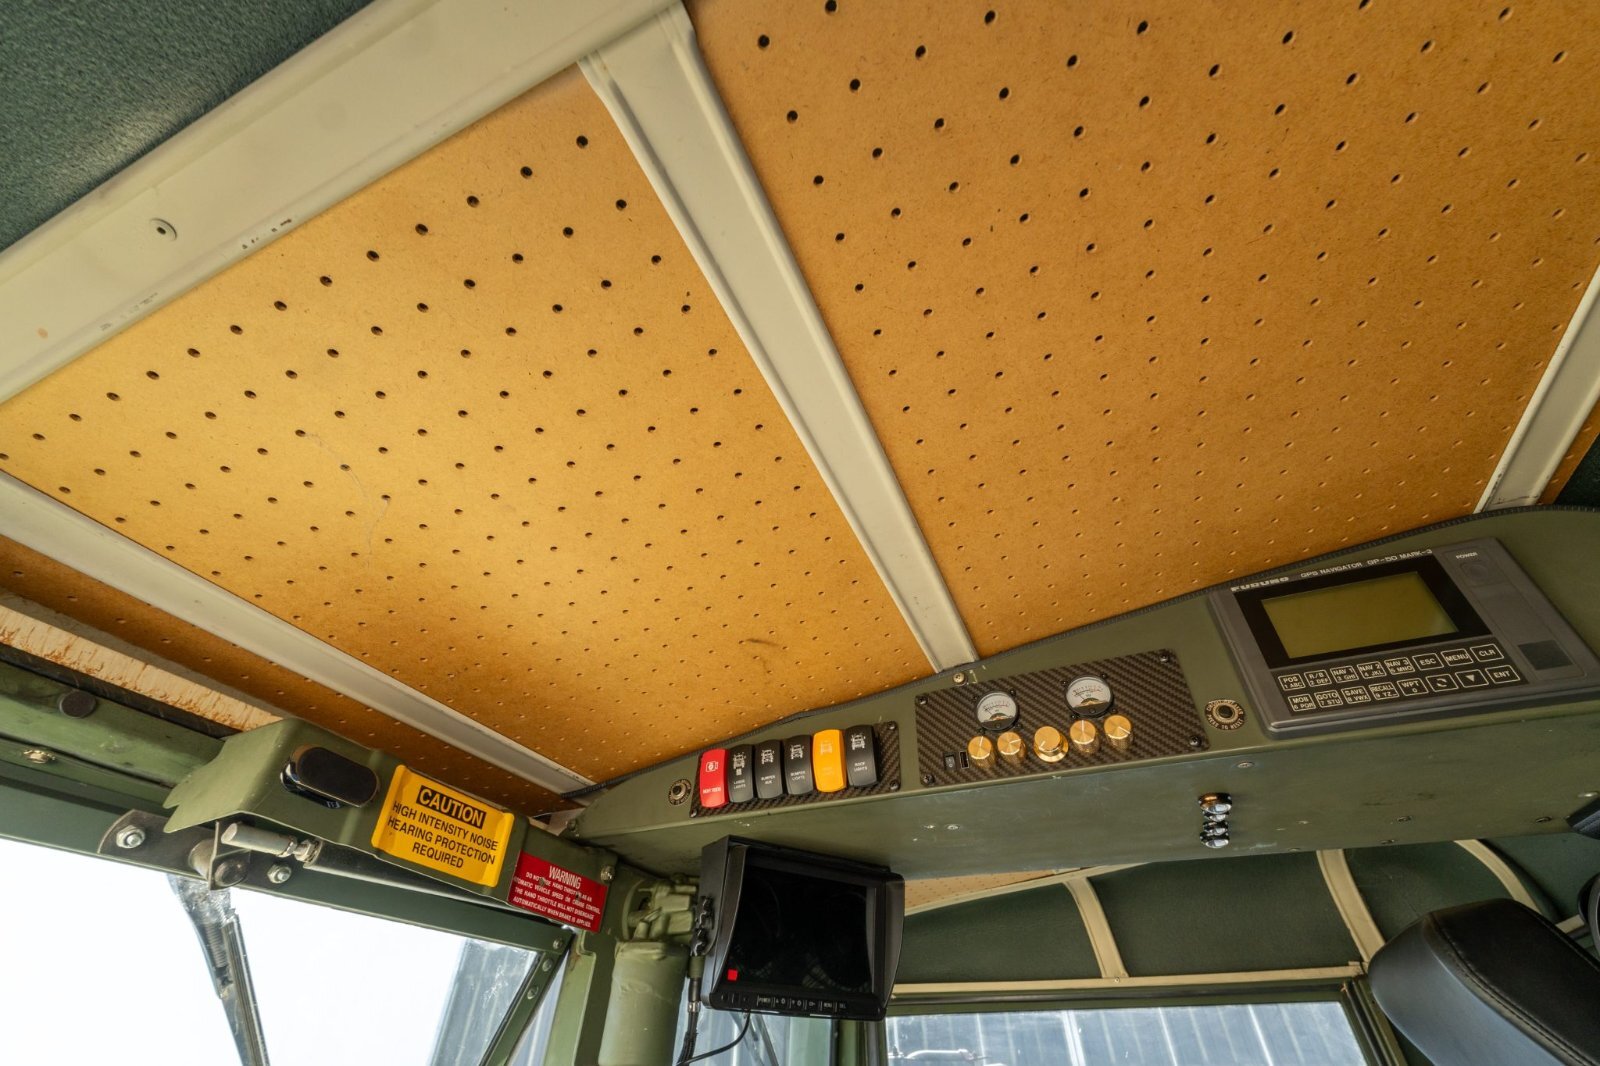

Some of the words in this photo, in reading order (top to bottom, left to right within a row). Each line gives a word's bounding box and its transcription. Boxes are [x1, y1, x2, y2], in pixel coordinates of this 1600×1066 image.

[1300, 570, 1319, 579] GPS
[1320, 562, 1363, 575] NAVIGATOR
[1367, 555, 1399, 567] GP-50
[1399, 549, 1434, 560] MARK-3
[1478, 649, 1496, 657] CLR
[1445, 653, 1470, 662] MENU
[1493, 671, 1511, 679] ENT
[1370, 684, 1394, 692] RECALL
[1401, 680, 1420, 688] WPT
[1318, 692, 1338, 700] GOTO
[1345, 688, 1364, 696] SAVE
[1292, 696, 1309, 704] MOB
[419, 788, 484, 828] CAUTION
[392, 801, 418, 820] HIGH
[418, 812, 469, 839] INTENSITY
[470, 832, 499, 851] NOISE
[387, 816, 433, 843] HEARING
[434, 834, 496, 865] PROTECTION
[412, 842, 464, 869] REQUIRED
[549, 866, 581, 889] WARNING
